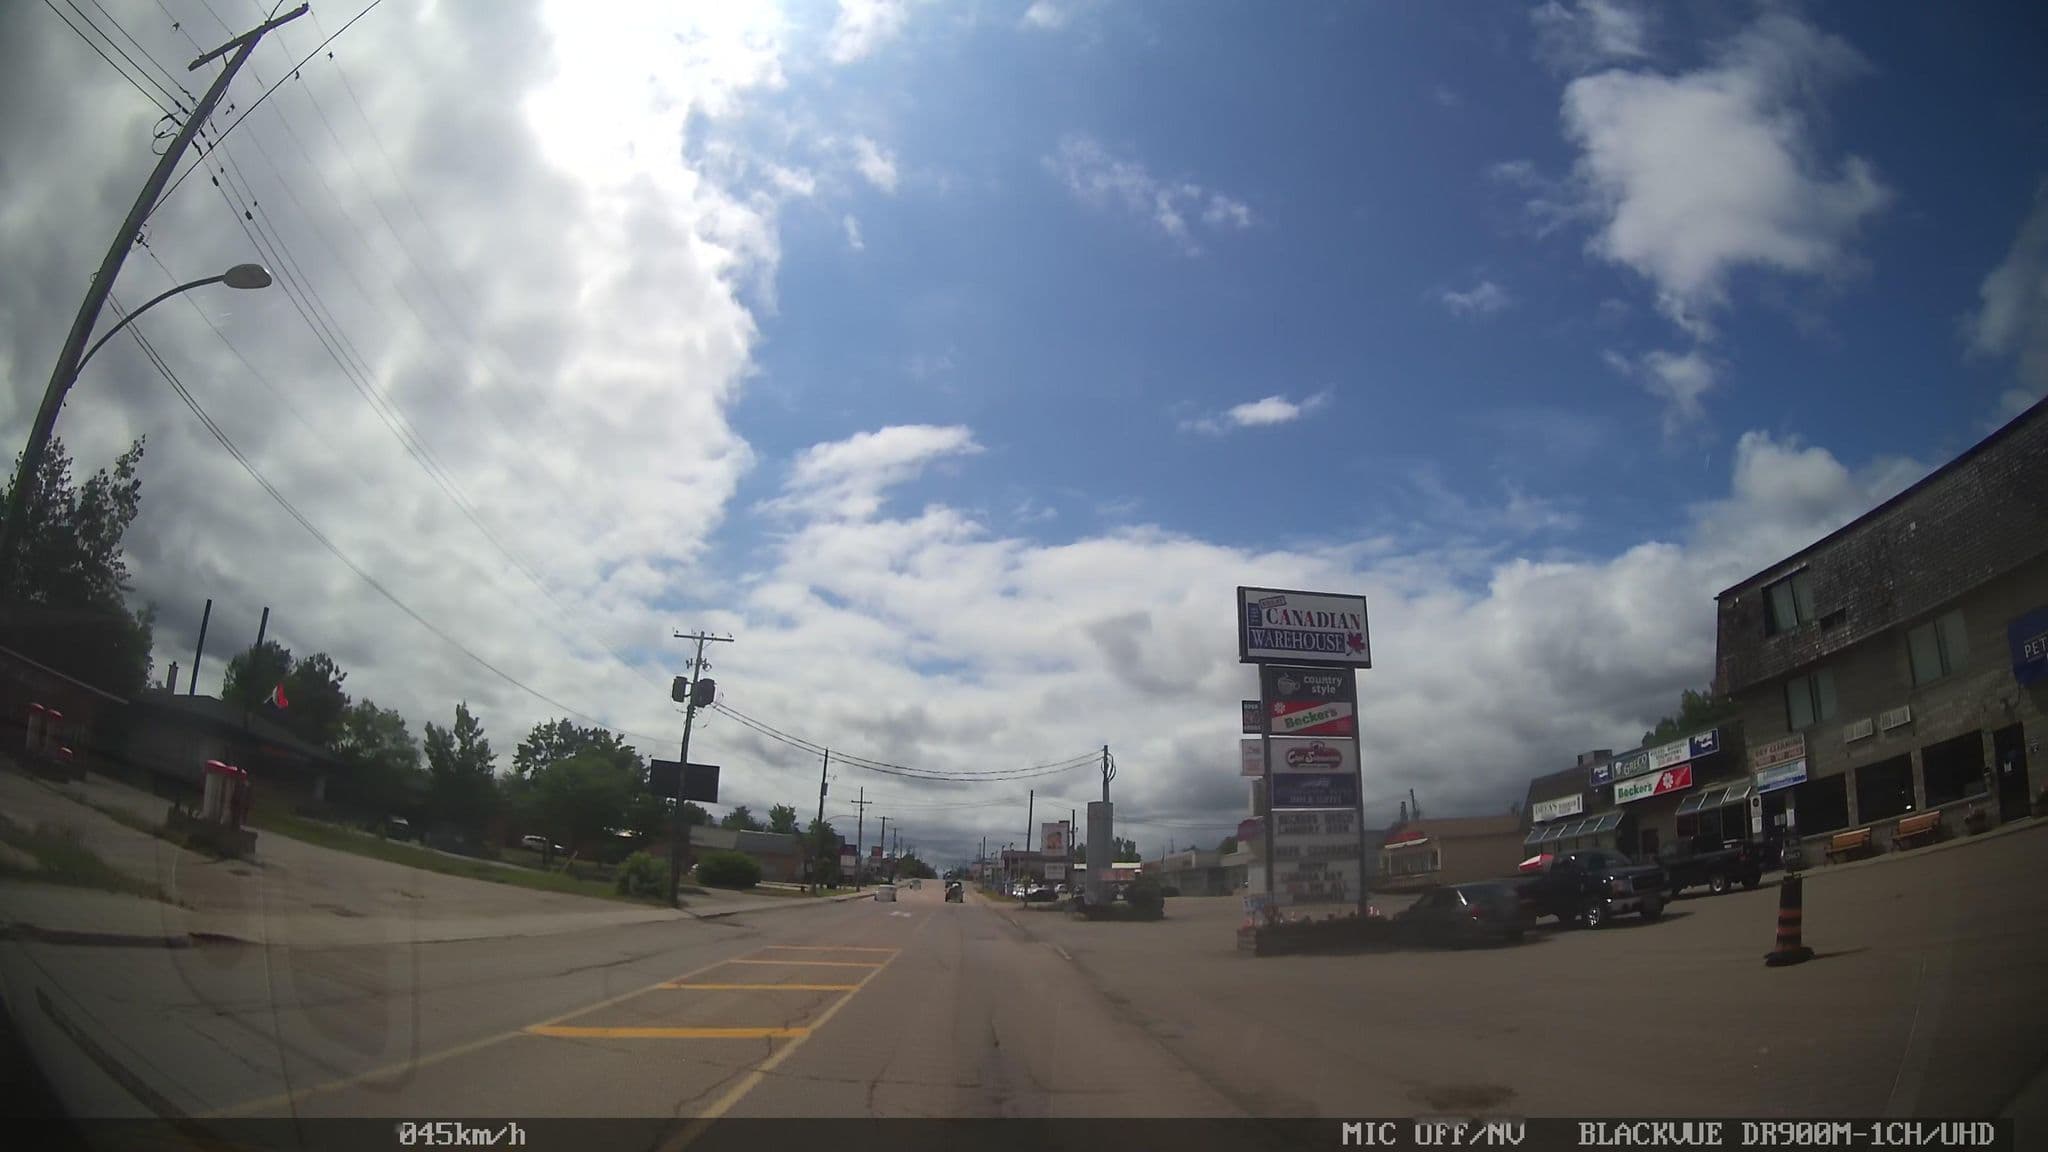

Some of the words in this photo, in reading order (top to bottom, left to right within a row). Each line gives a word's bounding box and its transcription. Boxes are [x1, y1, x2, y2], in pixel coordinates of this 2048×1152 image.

[1266, 608, 1360, 630] CANADIAN
[1250, 629, 1343, 653] WAREHOUSE
[1303, 674, 1343, 687] country
[1311, 684, 1336, 696] style
[1624, 752, 1648, 775] GRECO
